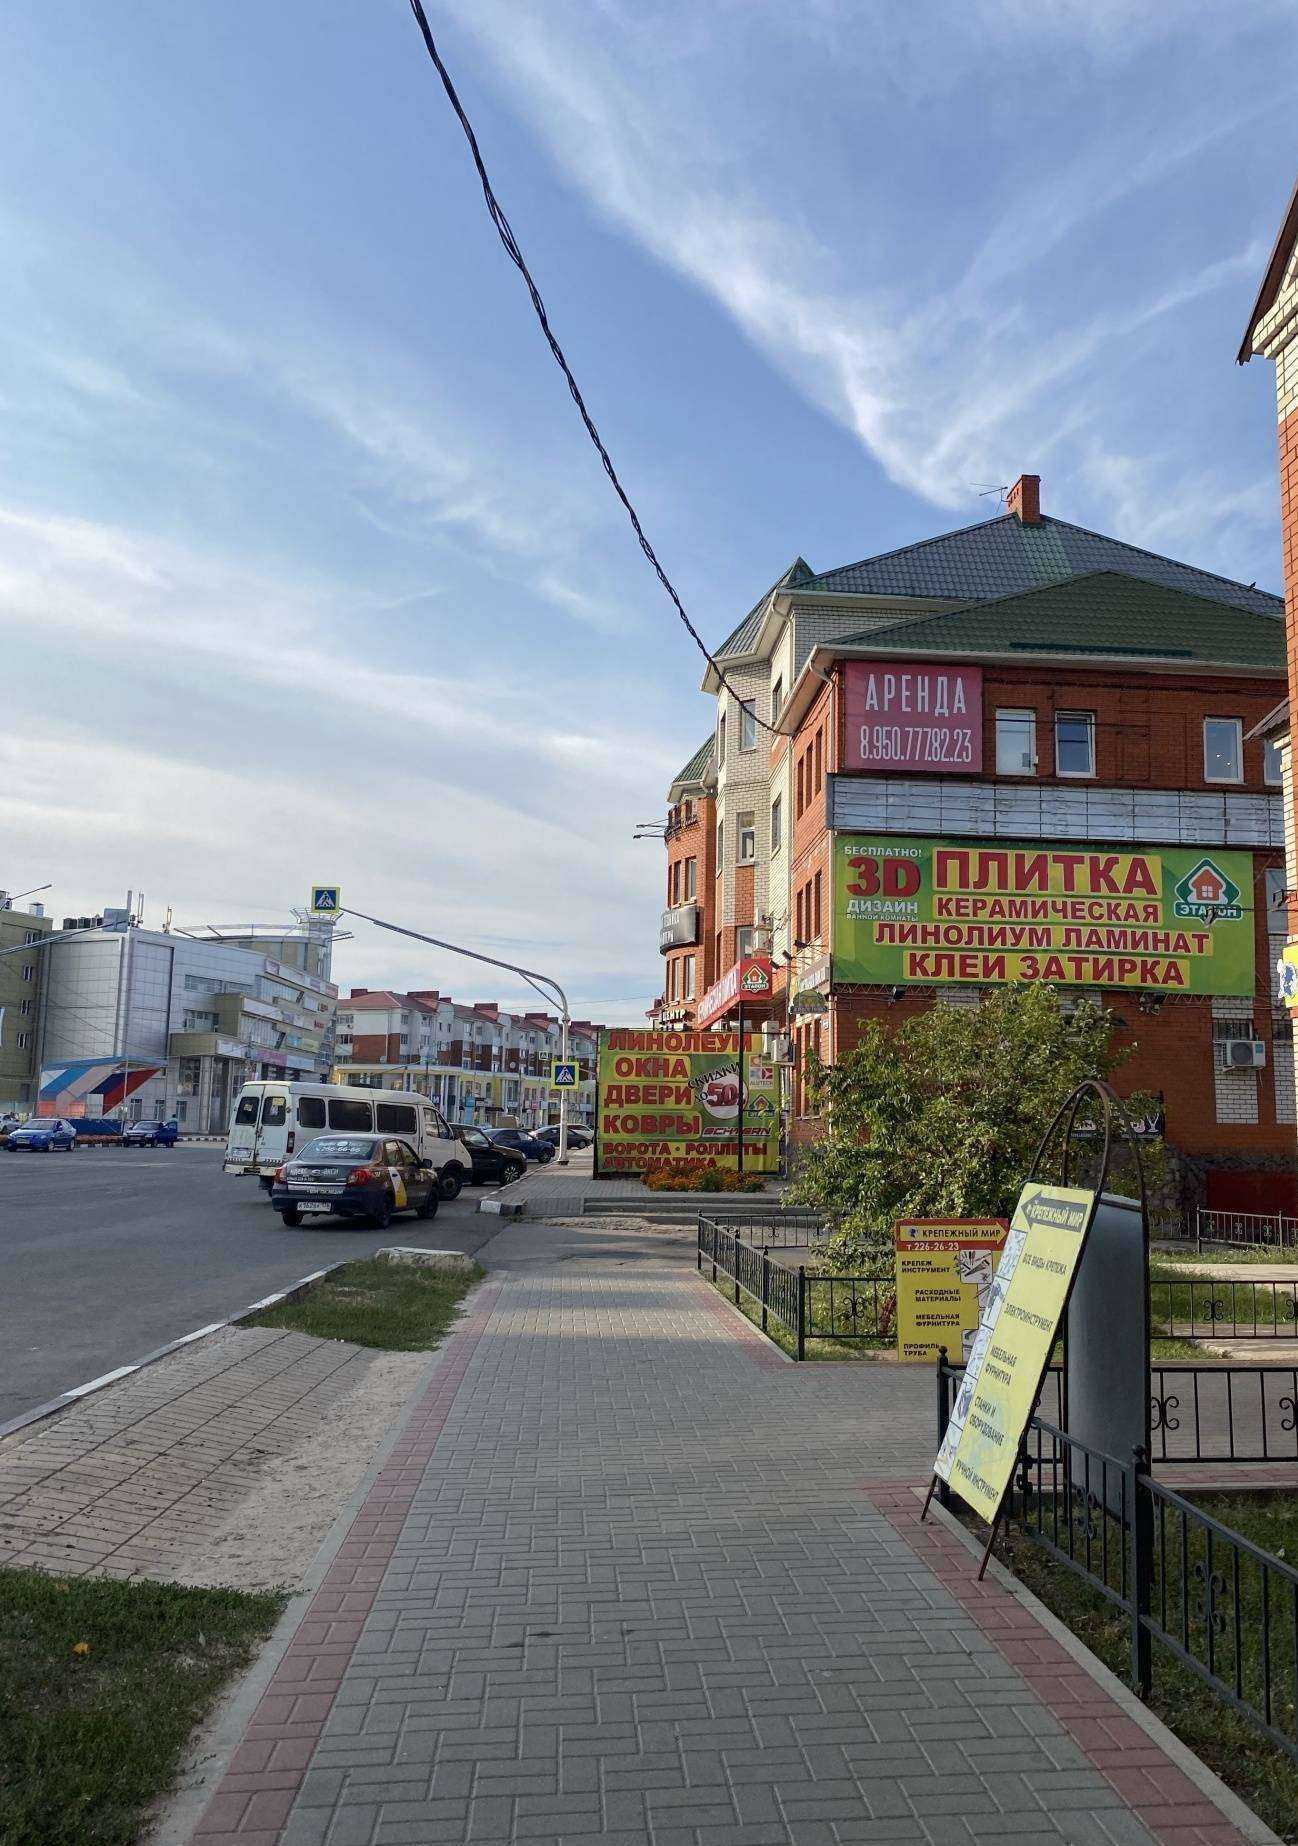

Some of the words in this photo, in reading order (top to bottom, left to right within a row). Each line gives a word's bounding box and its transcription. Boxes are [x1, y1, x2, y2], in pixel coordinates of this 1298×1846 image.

[865, 674, 967, 717] АРЕНДА
[844, 846, 922, 857] БЕСПЛАТНО!
[846, 857, 921, 897] 3D
[936, 851, 1158, 896] ПЛИТКА
[847, 899, 918, 913] ДИЗАЙН
[937, 898, 1160, 924] КЕРАМИЧЕСКАЯ
[1180, 904, 1237, 918] ЭТАОН
[875, 922, 1052, 948] ЛИНОЛИУМ
[1062, 928, 1209, 954] ЛАМИНАТ
[1019, 955, 1185, 986] ЗАТИРКА
[608, 1033, 752, 1052] ЛИНОЛЕУМ
[615, 1058, 689, 1078] ОКНА
[604, 1085, 692, 1108] ДВЕРИ
[603, 1113, 700, 1134] КОВРЫ
[603, 1143, 671, 1156] ВОРОТА
[922, 1228, 978, 1238] КРЕПЕЖНЫЙ
[981, 1230, 1001, 1238] МИР
